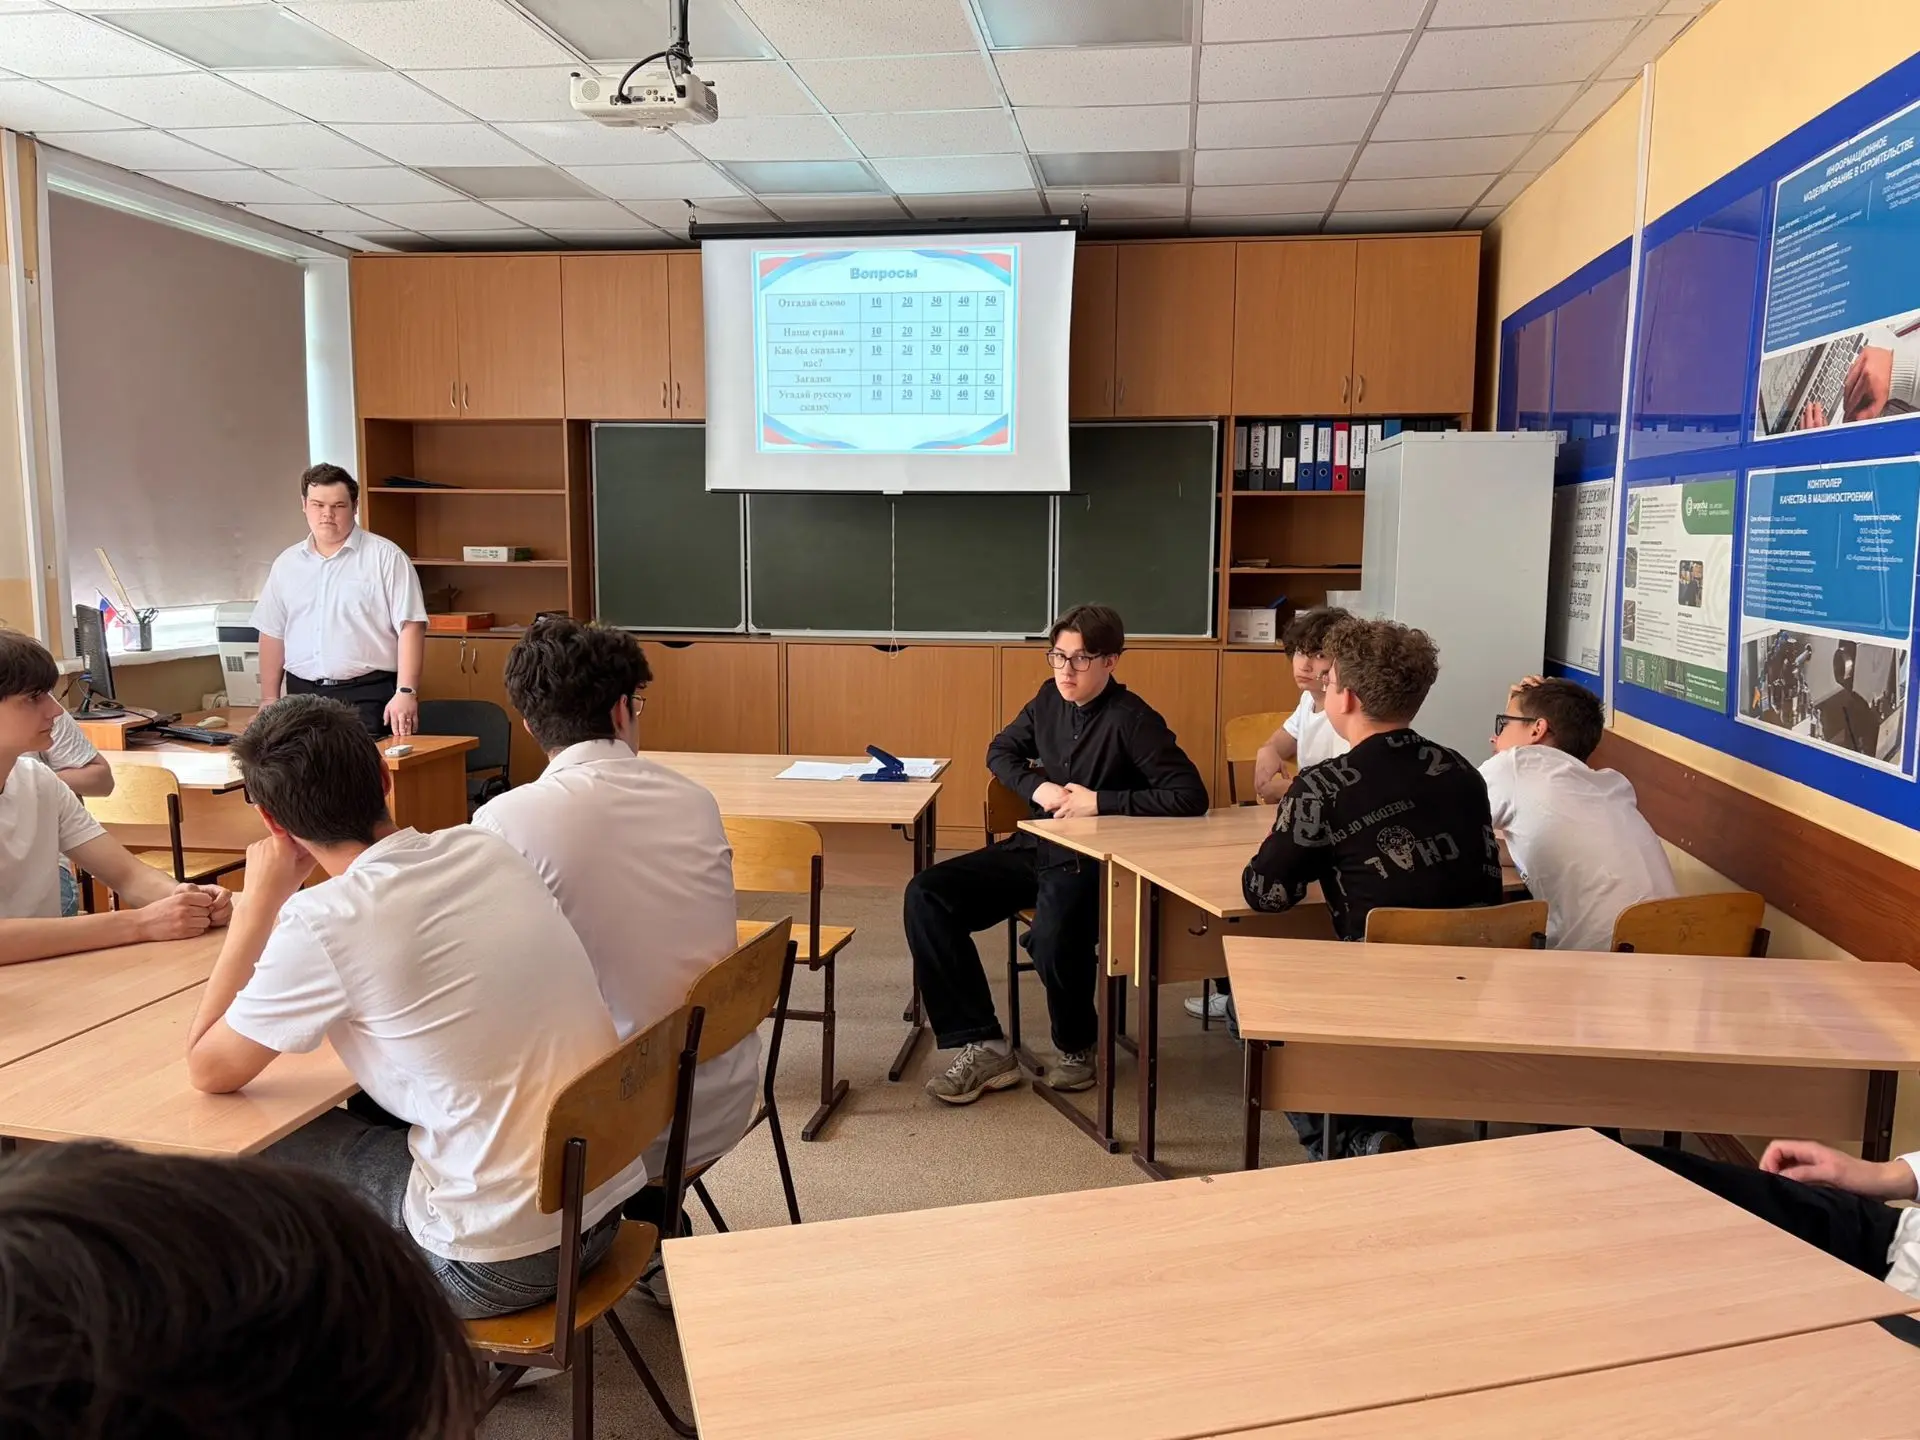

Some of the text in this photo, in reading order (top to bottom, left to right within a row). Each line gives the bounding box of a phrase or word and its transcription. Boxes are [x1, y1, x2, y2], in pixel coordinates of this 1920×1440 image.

[849, 267, 918, 281] Вопросы
[820, 299, 846, 307] слово
[871, 297, 882, 307] 10
[902, 296, 913, 307] 20
[931, 295, 942, 306] 30
[958, 295, 970, 306] 40
[984, 295, 997, 306] 50
[783, 327, 844, 338] Наша страна
[871, 327, 882, 337] 10
[902, 326, 913, 337] 20
[930, 326, 942, 337] 30
[957, 326, 969, 337] 40
[984, 325, 996, 337] 50
[774, 346, 793, 355] Как
[795, 345, 808, 355] бы
[810, 347, 846, 355] сказали
[871, 345, 882, 355] 10
[902, 345, 913, 355] 20
[930, 344, 942, 355] 30
[957, 344, 969, 355] 40
[984, 344, 996, 355] 50
[803, 358, 824, 368] нас?
[871, 374, 882, 384] 10
[902, 373, 913, 384] 20
[930, 373, 942, 384] 30
[957, 373, 969, 384] 40
[984, 373, 996, 384] 50
[871, 389, 882, 400] 10
[901, 389, 913, 400] 20
[930, 389, 942, 400] 30
[957, 389, 969, 400] 40
[984, 389, 995, 400] 50
